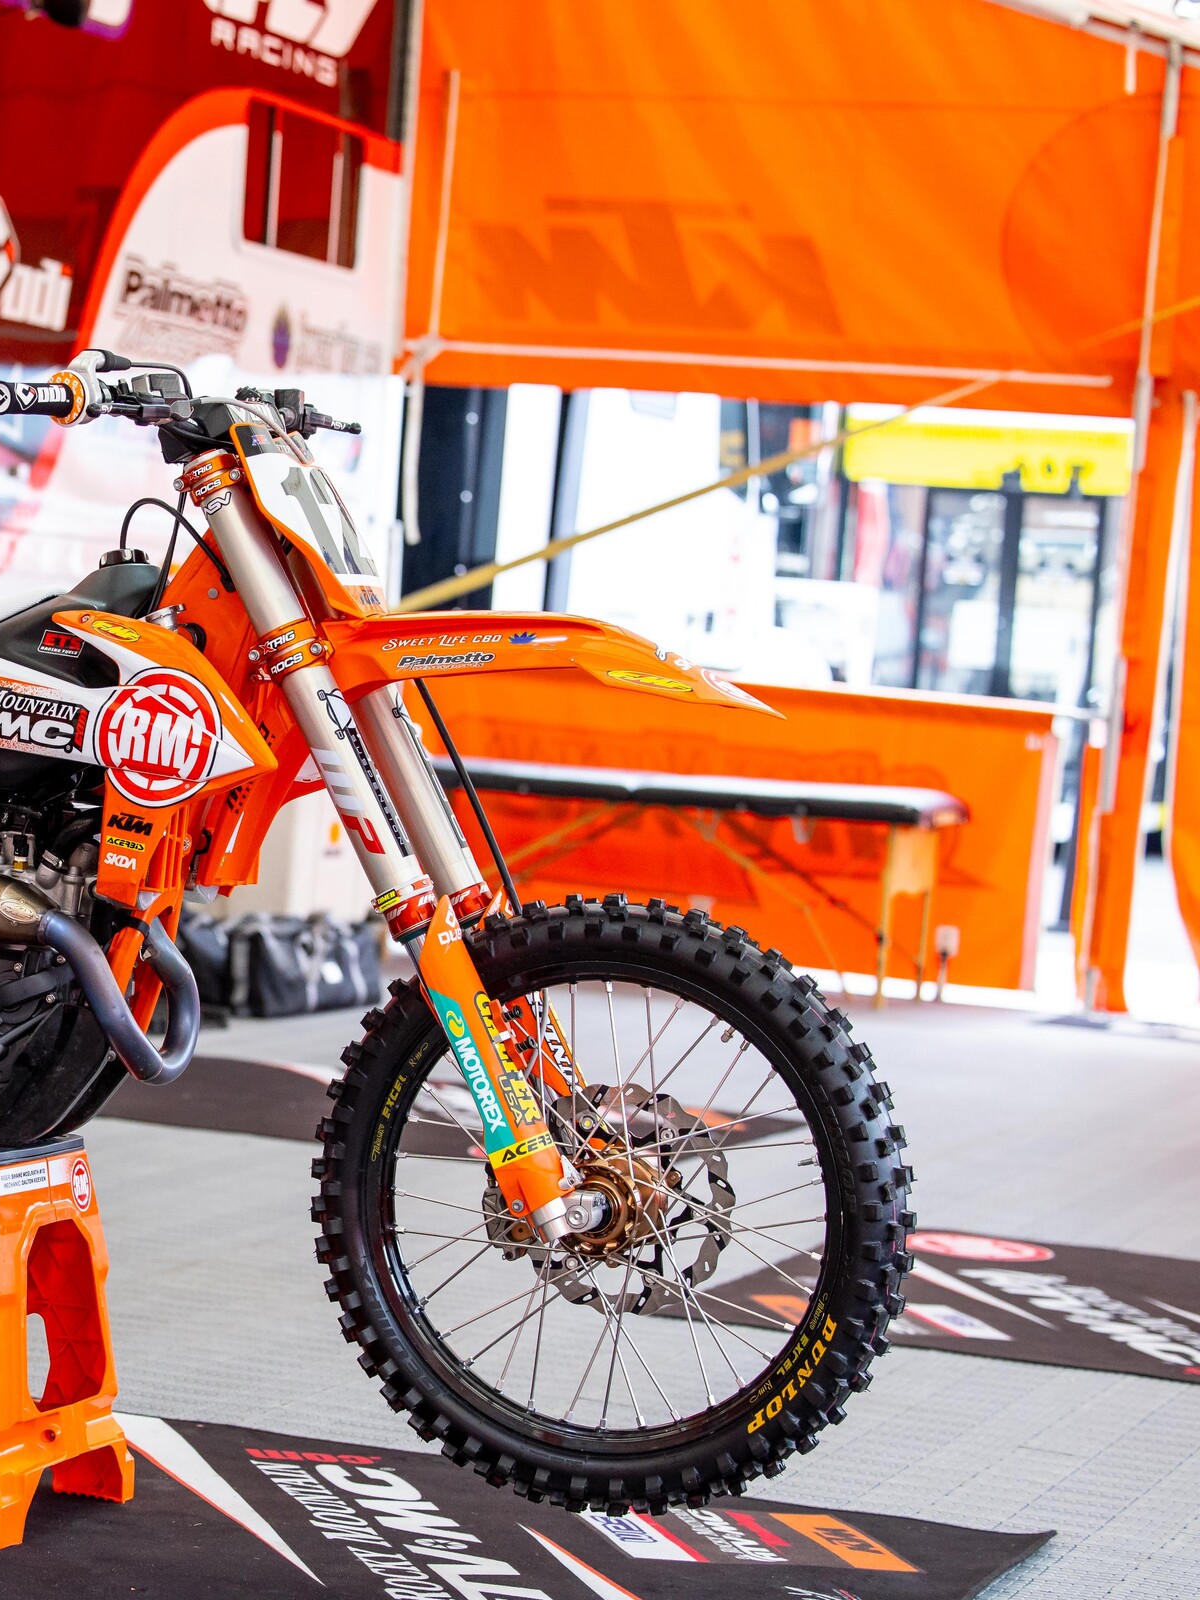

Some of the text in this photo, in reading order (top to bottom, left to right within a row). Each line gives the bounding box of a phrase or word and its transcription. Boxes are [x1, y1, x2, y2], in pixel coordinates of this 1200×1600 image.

[210, 16, 337, 88] RACING
[189, 463, 213, 482] XTRIG
[195, 478, 221, 498] ROCS
[43, 632, 81, 651] ETS
[259, 630, 295, 654] XTRIG
[382, 634, 503, 651] SWEET LIFE CBD
[270, 652, 303, 676] ROCS
[397, 651, 496, 669] Palmetto
[350, 733, 405, 846] SUSPENSION
[107, 812, 153, 836] KTM
[104, 852, 137, 870] SKDA
[384, 1074, 408, 1119] EXCEL
[455, 1036, 507, 1134] MOTOREX
[498, 1075, 523, 1126] USA
[776, 1333, 809, 1376] EXCEL
[748, 1314, 837, 1434] DUNLOP
[250, 1459, 393, 1549] MOUNTAIN
